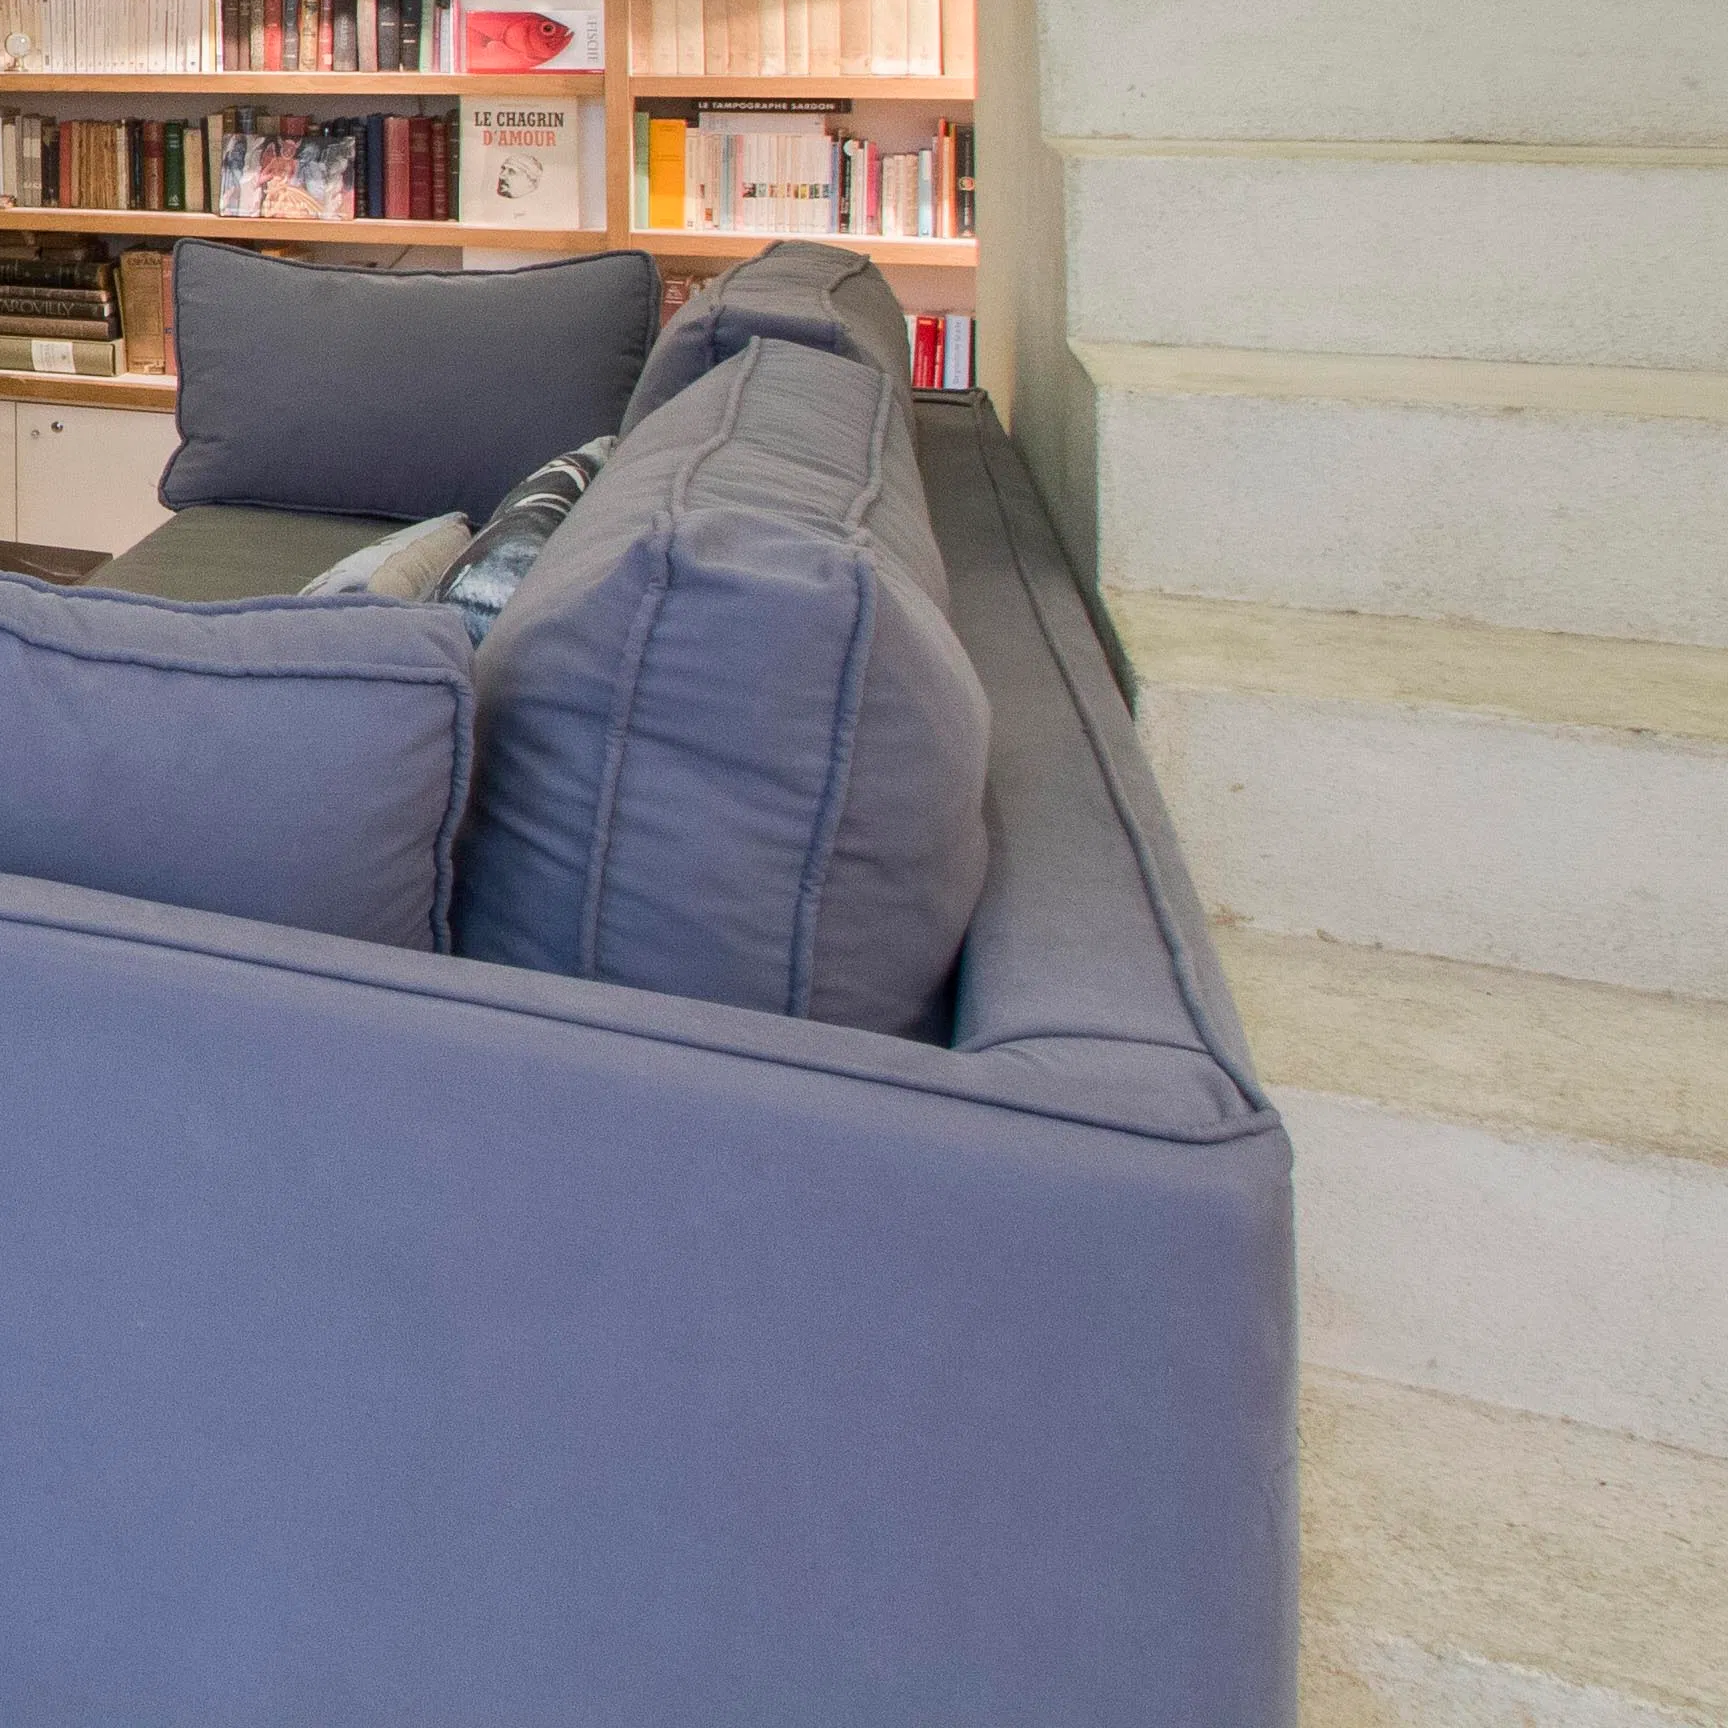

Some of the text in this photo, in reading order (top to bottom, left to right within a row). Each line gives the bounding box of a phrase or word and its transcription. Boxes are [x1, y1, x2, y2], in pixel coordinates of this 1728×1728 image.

[697, 101, 837, 112] LE TAMPOGRAPHE SARDON
[473, 111, 565, 128] LE CHAGRIN
[482, 130, 557, 148] D'AMOUR
